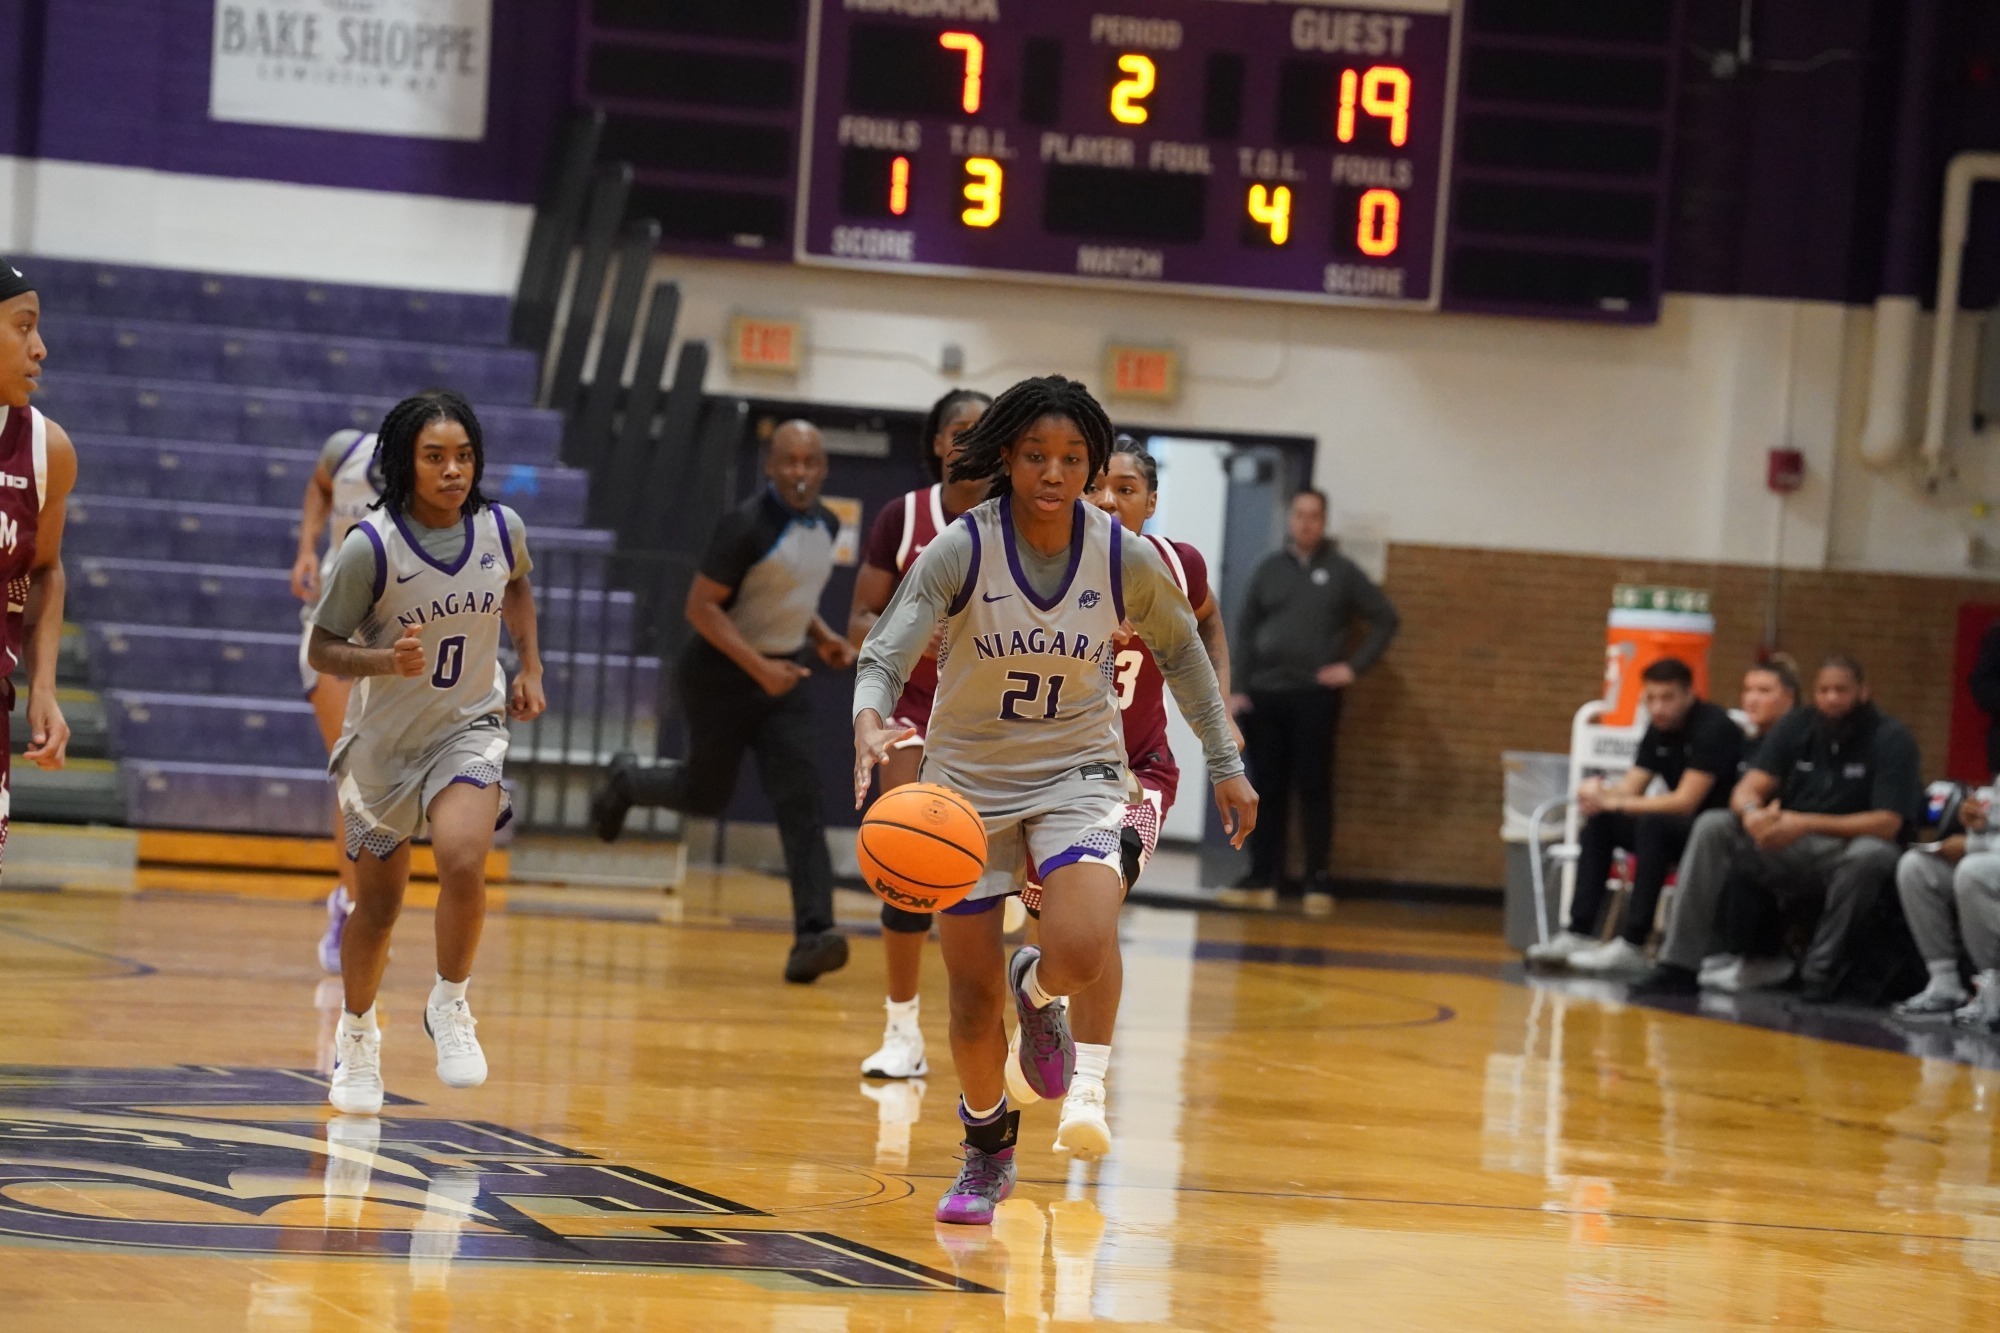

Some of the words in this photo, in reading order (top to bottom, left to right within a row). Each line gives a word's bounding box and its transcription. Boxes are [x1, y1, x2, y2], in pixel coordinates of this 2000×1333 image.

[222, 6, 318, 62] BAKE
[337, 16, 475, 76] SHOPPE
[1091, 14, 1183, 50] PERIOD
[1292, 8, 1411, 56] GUEST
[940, 32, 983, 114] 7
[1110, 54, 1155, 124] 2
[1337, 66, 1411, 146] 19
[838, 115, 921, 152] FOULS
[1040, 132, 1135, 168] PLAYER
[1149, 141, 1214, 175] FOUL
[889, 156, 909, 215] 1
[962, 157, 1002, 227] 3
[1331, 154, 1412, 189] FOULS
[1249, 184, 1291, 245] 4
[1357, 188, 1400, 257] 0
[831, 225, 916, 260] SCORE
[1323, 262, 1404, 296] SCORE
[431, 635, 467, 689] 0
[971, 627, 1106, 664] NIAGARA
[998, 669, 1066, 720] 21
